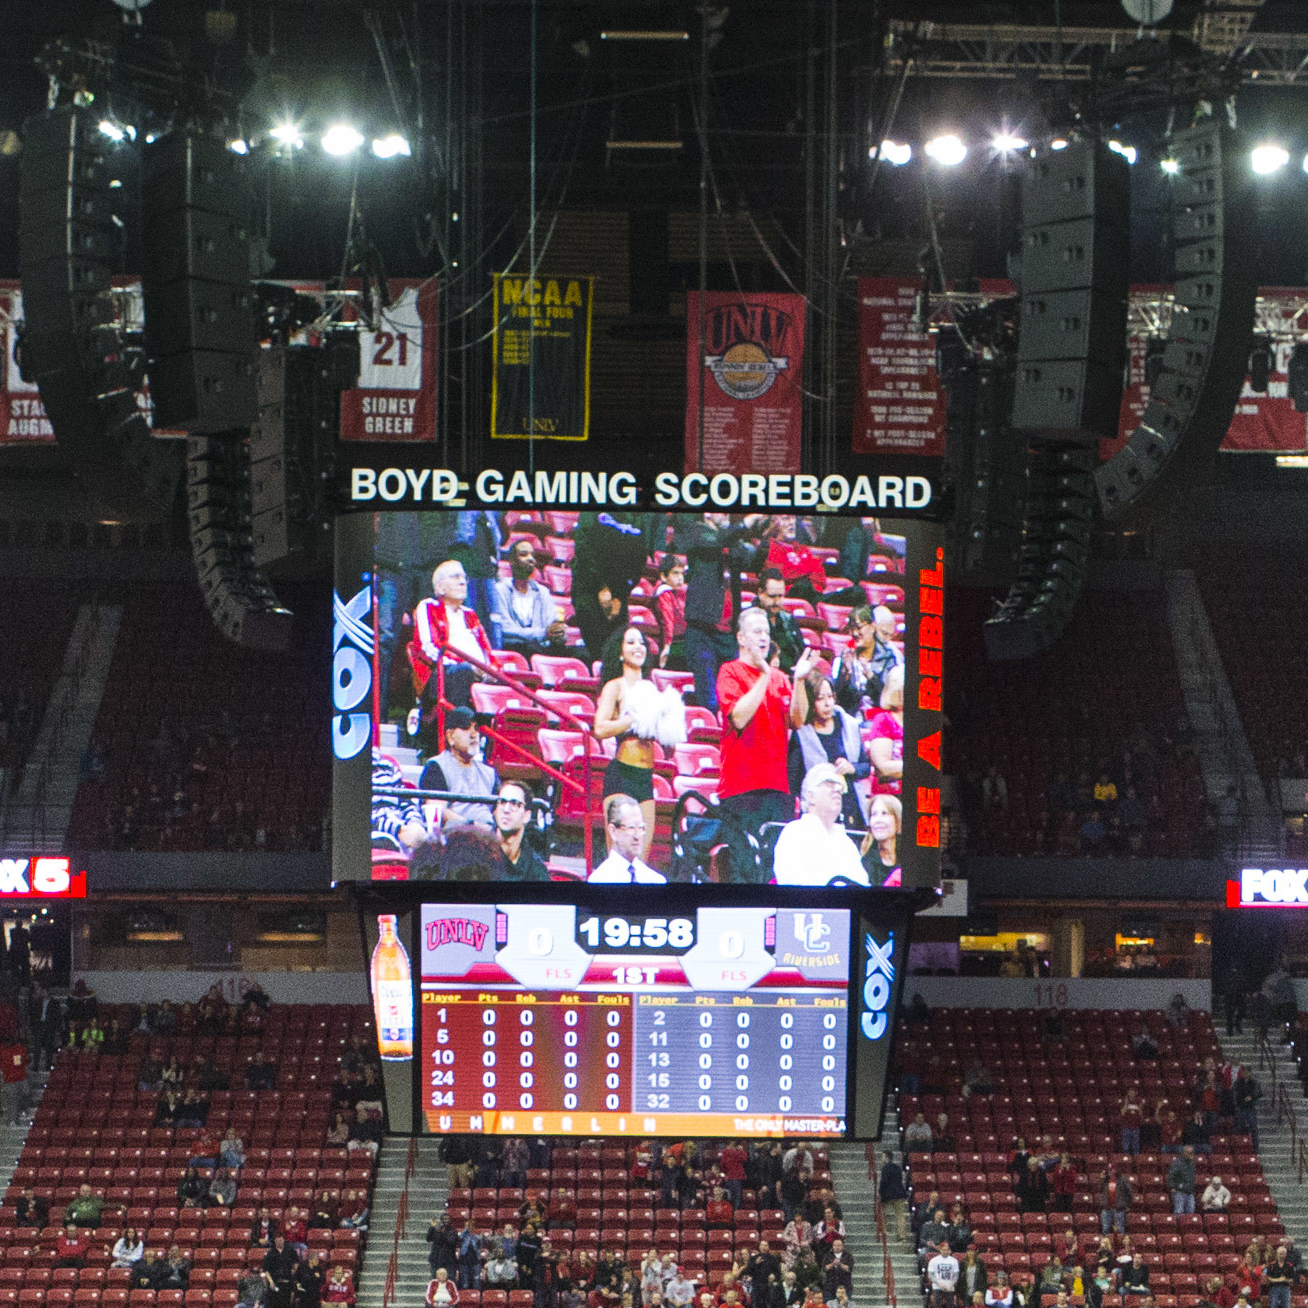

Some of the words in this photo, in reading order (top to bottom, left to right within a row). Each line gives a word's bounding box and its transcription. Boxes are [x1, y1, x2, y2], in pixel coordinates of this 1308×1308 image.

[502, 279, 582, 306] NCAA
[372, 332, 409, 366] 21
[362, 397, 417, 415] SIDNEY
[365, 417, 414, 434] GREEN
[351, 468, 459, 502] BOYD
[477, 471, 637, 506] GAMING
[656, 473, 932, 509] SCOREBOARD
[917, 546, 944, 712] REBEL.
[333, 572, 375, 759] COX
[917, 730, 942, 771] A
[916, 786, 941, 848] BE
[33, 857, 71, 892] 5
[426, 918, 489, 951] UNLV
[528, 927, 554, 957] 0
[579, 917, 694, 949] 19:58
[719, 930, 745, 960] 0
[546, 968, 571, 979] FLS
[613, 966, 659, 985] 1ST
[721, 970, 747, 981] FLS
[783, 952, 841, 967] RIVERSIDE
[861, 931, 896, 1040] COX
[1033, 984, 1069, 1006] 118
[422, 993, 461, 1003] Player
[478, 993, 498, 1002] Pts
[516, 994, 536, 1003] Reb
[560, 995, 579, 1004] Ast
[597, 995, 629, 1004] Fouls
[639, 996, 678, 1006] Player
[695, 996, 715, 1006] Pts
[733, 996, 753, 1006] Reb
[777, 997, 797, 1006] Ast
[814, 997, 846, 1007] Fouls
[438, 1009, 447, 1022] 1
[483, 1010, 496, 1025] 0
[520, 1010, 533, 1025] 0
[564, 1011, 577, 1026] 0
[606, 1011, 619, 1026] 0
[654, 1011, 665, 1025] 2
[700, 1012, 712, 1027] 0
[737, 1013, 750, 1028] 0
[781, 1013, 793, 1028] 0
[824, 1014, 836, 1029] 0
[437, 1030, 449, 1044] 5
[483, 1030, 496, 1046] 0
[520, 1031, 533, 1046] 0
[564, 1031, 577, 1046] 0
[606, 1032, 619, 1047] 0
[649, 1032, 667, 1046] 11
[700, 1033, 712, 1048] 0
[737, 1034, 749, 1049] 0
[780, 1034, 793, 1049] 0
[823, 1035, 836, 1050] 0
[432, 1050, 454, 1064] 10
[483, 1051, 496, 1066] 0
[520, 1051, 533, 1067] 0
[564, 1052, 577, 1067] 0
[606, 1053, 619, 1068] 0
[648, 1053, 669, 1067] 13
[699, 1054, 712, 1069] 0
[736, 1054, 749, 1069] 0
[780, 1055, 792, 1070] 0
[822, 1055, 835, 1070] 0
[432, 1071, 454, 1085] 24
[483, 1072, 496, 1087] 0
[520, 1072, 533, 1087] 0
[564, 1073, 577, 1088] 0
[606, 1073, 619, 1089] 0
[648, 1073, 669, 1087] 15
[699, 1075, 711, 1089] 0
[736, 1075, 748, 1090] 0
[779, 1075, 792, 1090] 0
[822, 1076, 834, 1091] 0
[432, 1091, 454, 1105] 34
[483, 1093, 496, 1108] 0
[520, 1093, 533, 1108] 0
[564, 1093, 577, 1109] 0
[606, 1094, 619, 1109] 0
[647, 1094, 669, 1108] 32
[699, 1095, 711, 1110] 0
[736, 1096, 748, 1111] 0
[779, 1096, 791, 1111] 0
[821, 1096, 834, 1111] 0
[734, 1119, 755, 1131] THE
[756, 1119, 784, 1131] ONLY
